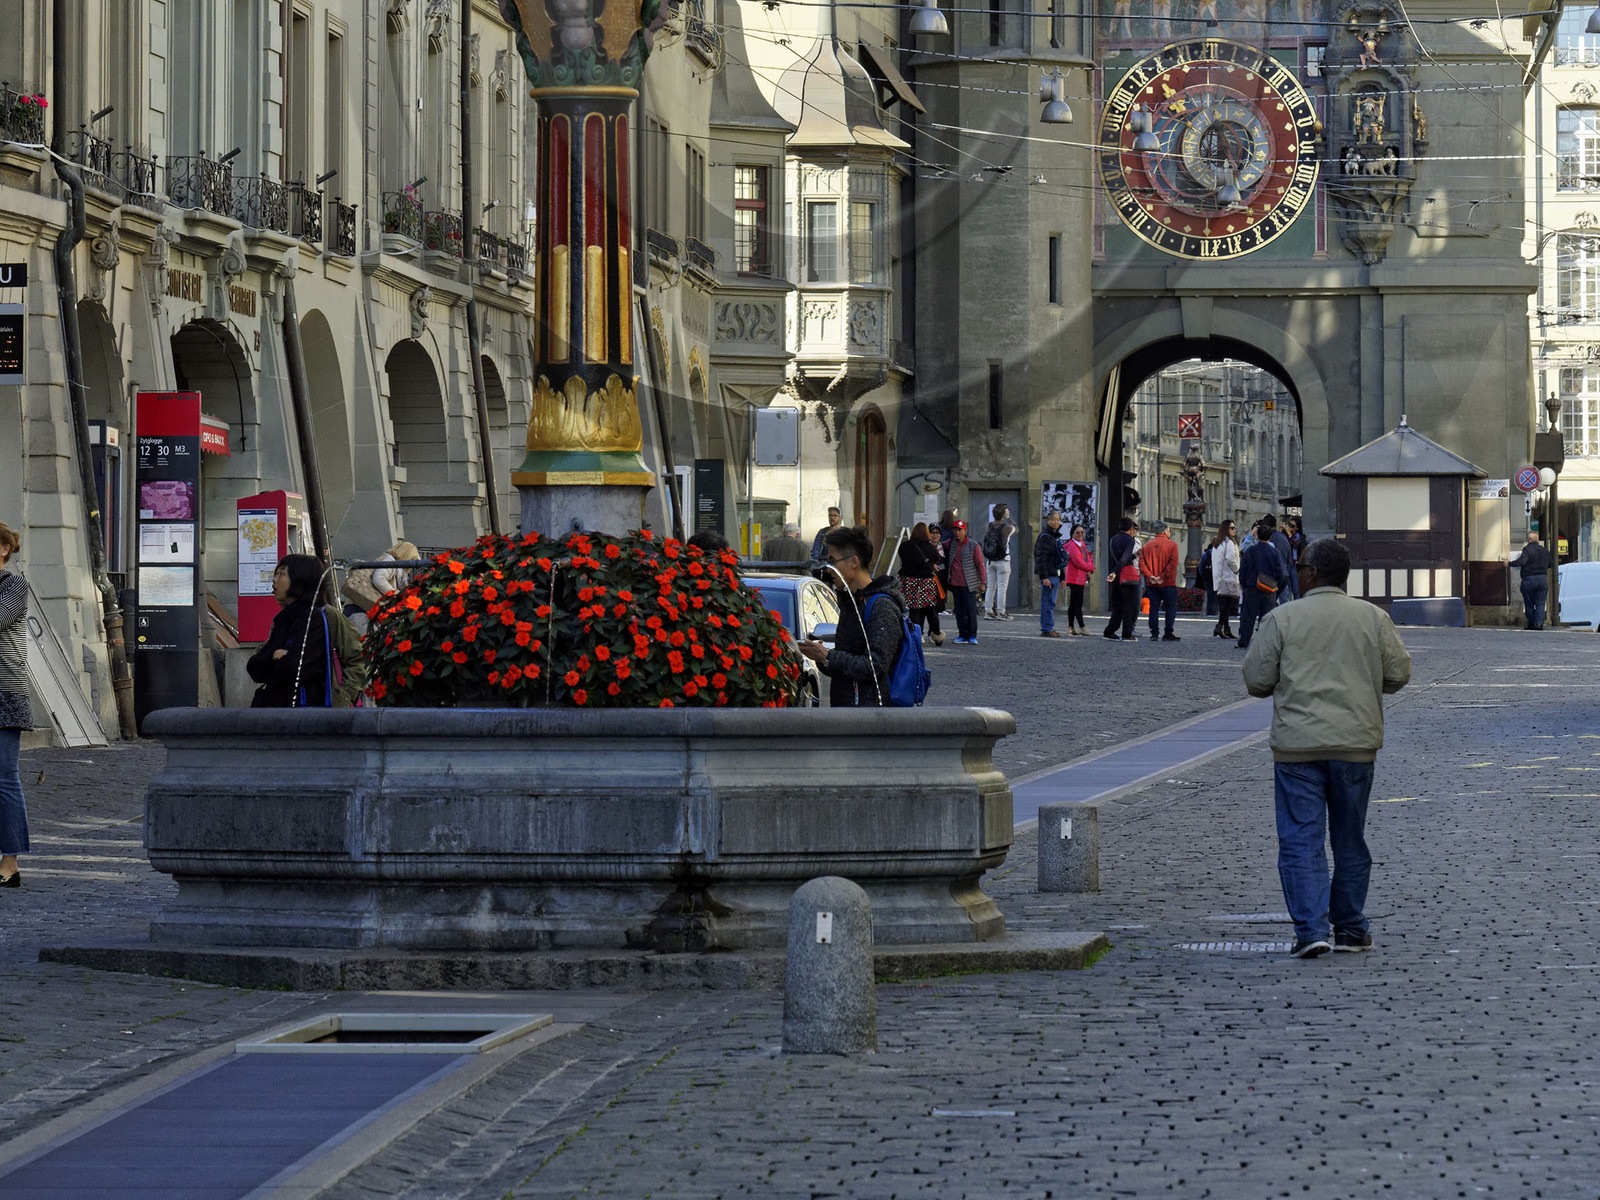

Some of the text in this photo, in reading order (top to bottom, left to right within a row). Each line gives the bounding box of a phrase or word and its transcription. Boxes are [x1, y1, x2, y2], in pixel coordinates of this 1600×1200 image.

[1269, 69, 1288, 89] III
[140, 445, 186, 456] 12 30 M3
